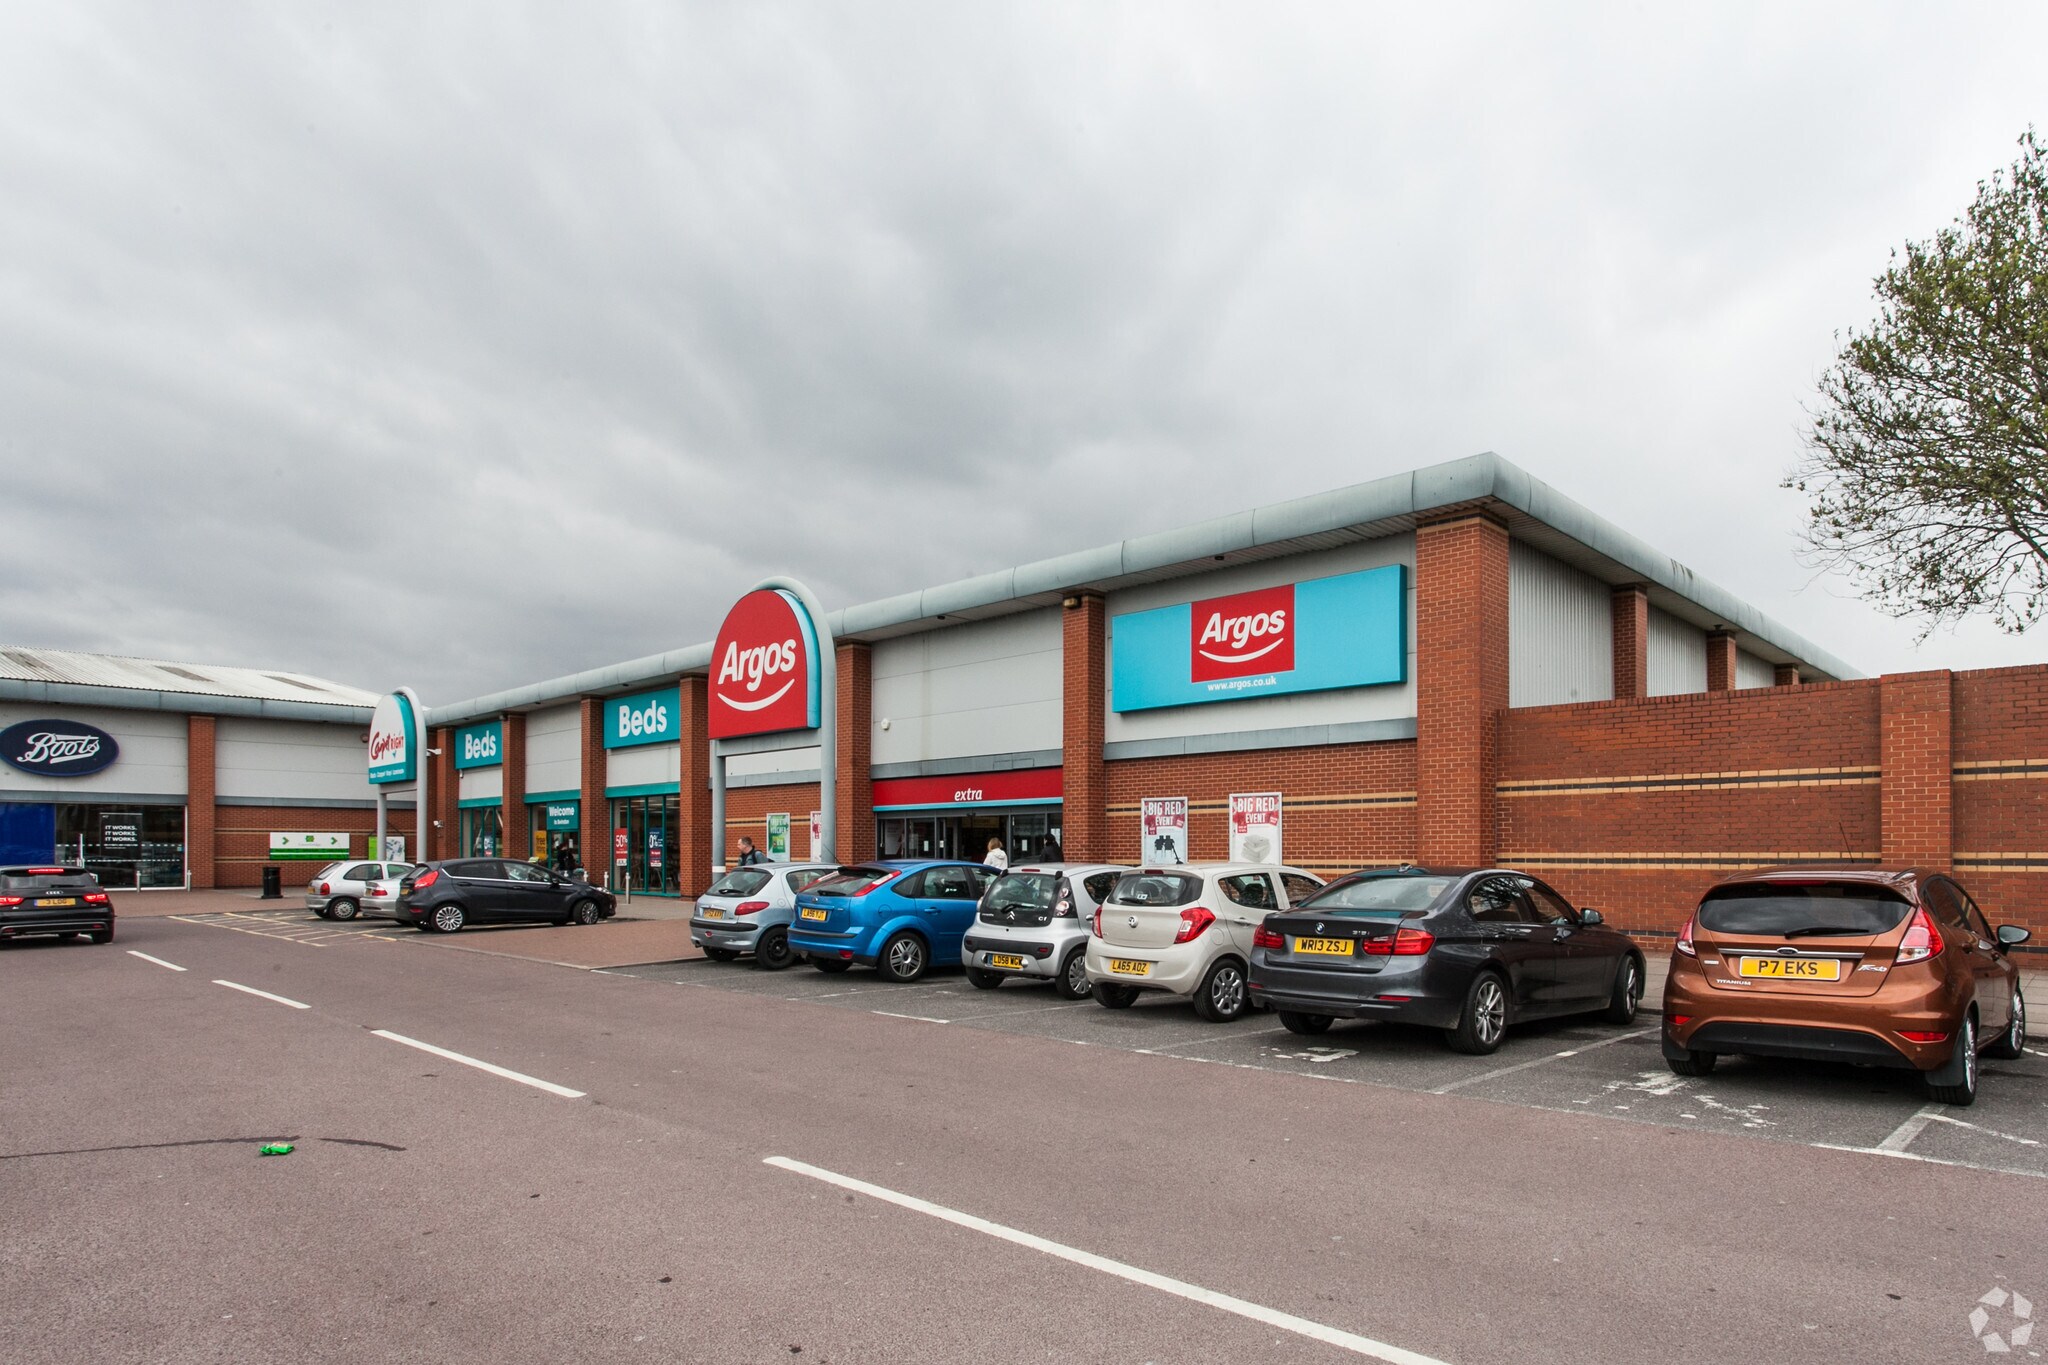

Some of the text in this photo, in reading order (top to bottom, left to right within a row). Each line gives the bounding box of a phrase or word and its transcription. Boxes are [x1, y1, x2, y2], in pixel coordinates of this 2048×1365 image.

[1199, 610, 1286, 649] Argos
[717, 639, 797, 692] Argos
[1207, 675, 1277, 691] www.argos.co.uk
[619, 700, 668, 738] Beds
[17, 732, 100, 764] Boots
[465, 730, 496, 760] Beds
[954, 787, 983, 801] extra
[549, 806, 575, 817] Welcome
[1148, 801, 1181, 816] BIG RED
[1238, 796, 1275, 813] BIG RED
[1156, 816, 1174, 826] EVENT
[1246, 812, 1266, 824] EVENT
[1301, 939, 1348, 953] WR13 ZSJ
[1112, 959, 1131, 972] LA65
[1758, 960, 1818, 976] P7 EKS
[1716, 978, 1752, 986] TITANIUM
